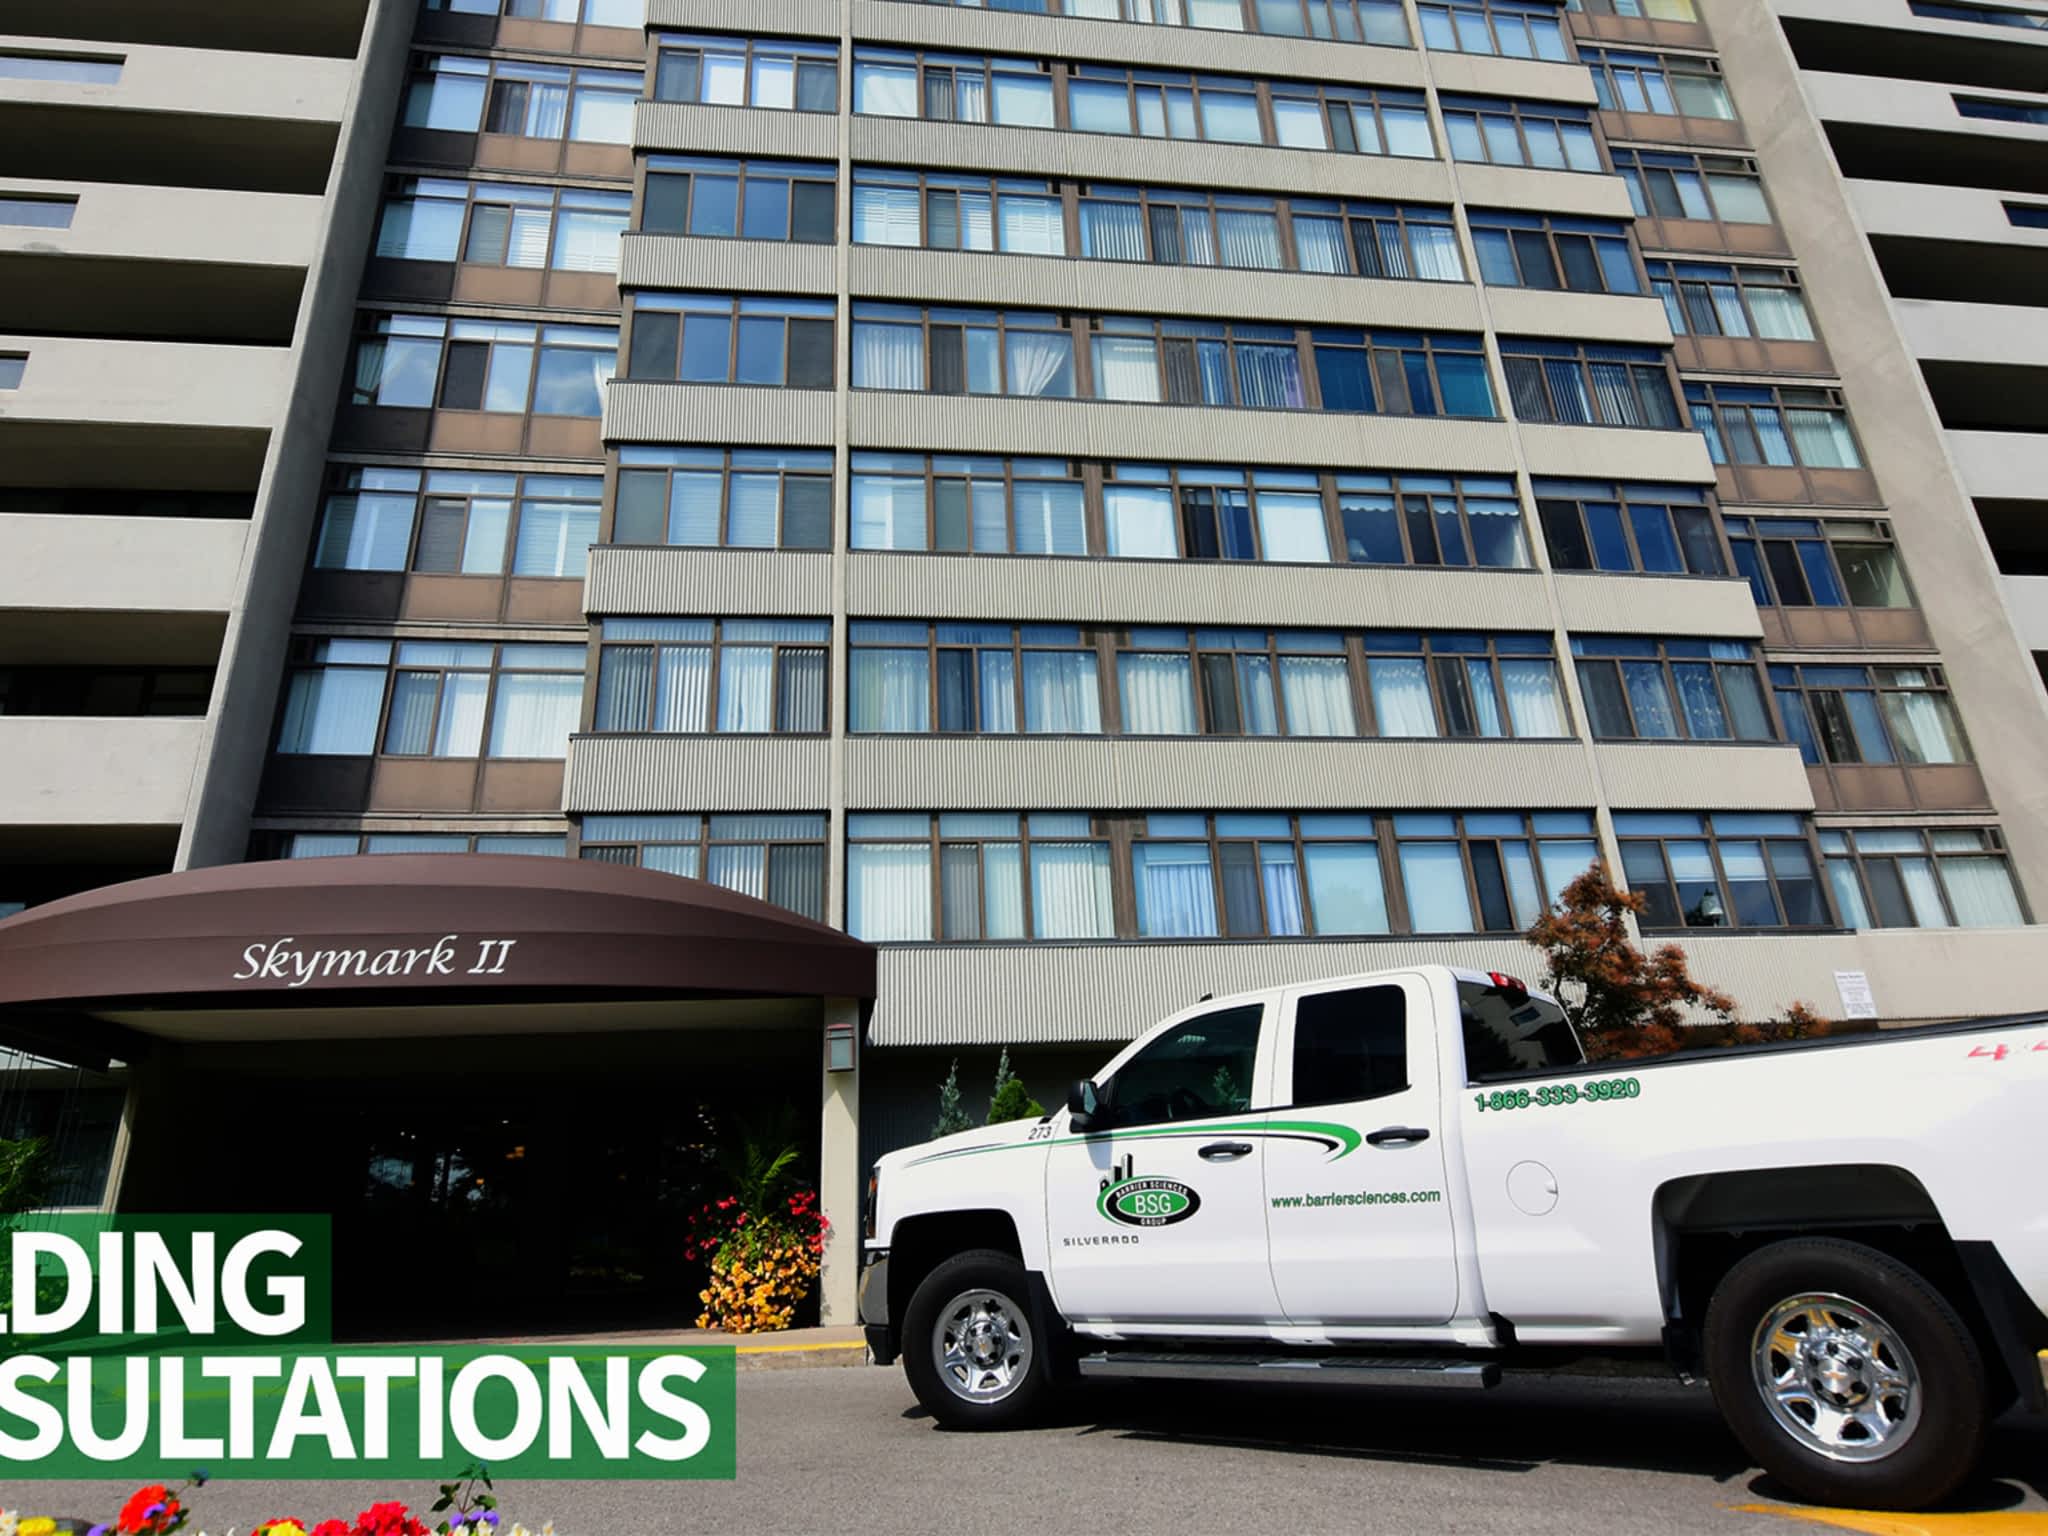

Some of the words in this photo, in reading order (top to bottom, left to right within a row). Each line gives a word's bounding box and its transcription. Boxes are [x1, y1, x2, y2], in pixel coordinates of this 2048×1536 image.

[233, 934, 458, 987] Skymark
[467, 939, 517, 974] II
[1474, 1077, 1641, 1112] 1-866-333-3920
[1028, 1125, 1053, 1140] 273
[1115, 1181, 1147, 1198] BARRIER
[1149, 1181, 1188, 1196] SCIENCES
[1271, 1189, 1441, 1208] www.barriersciences.com
[1135, 1194, 1171, 1214] BSG
[1140, 1217, 1167, 1226] GROUP
[1063, 1235, 1139, 1247] SILVERADO
